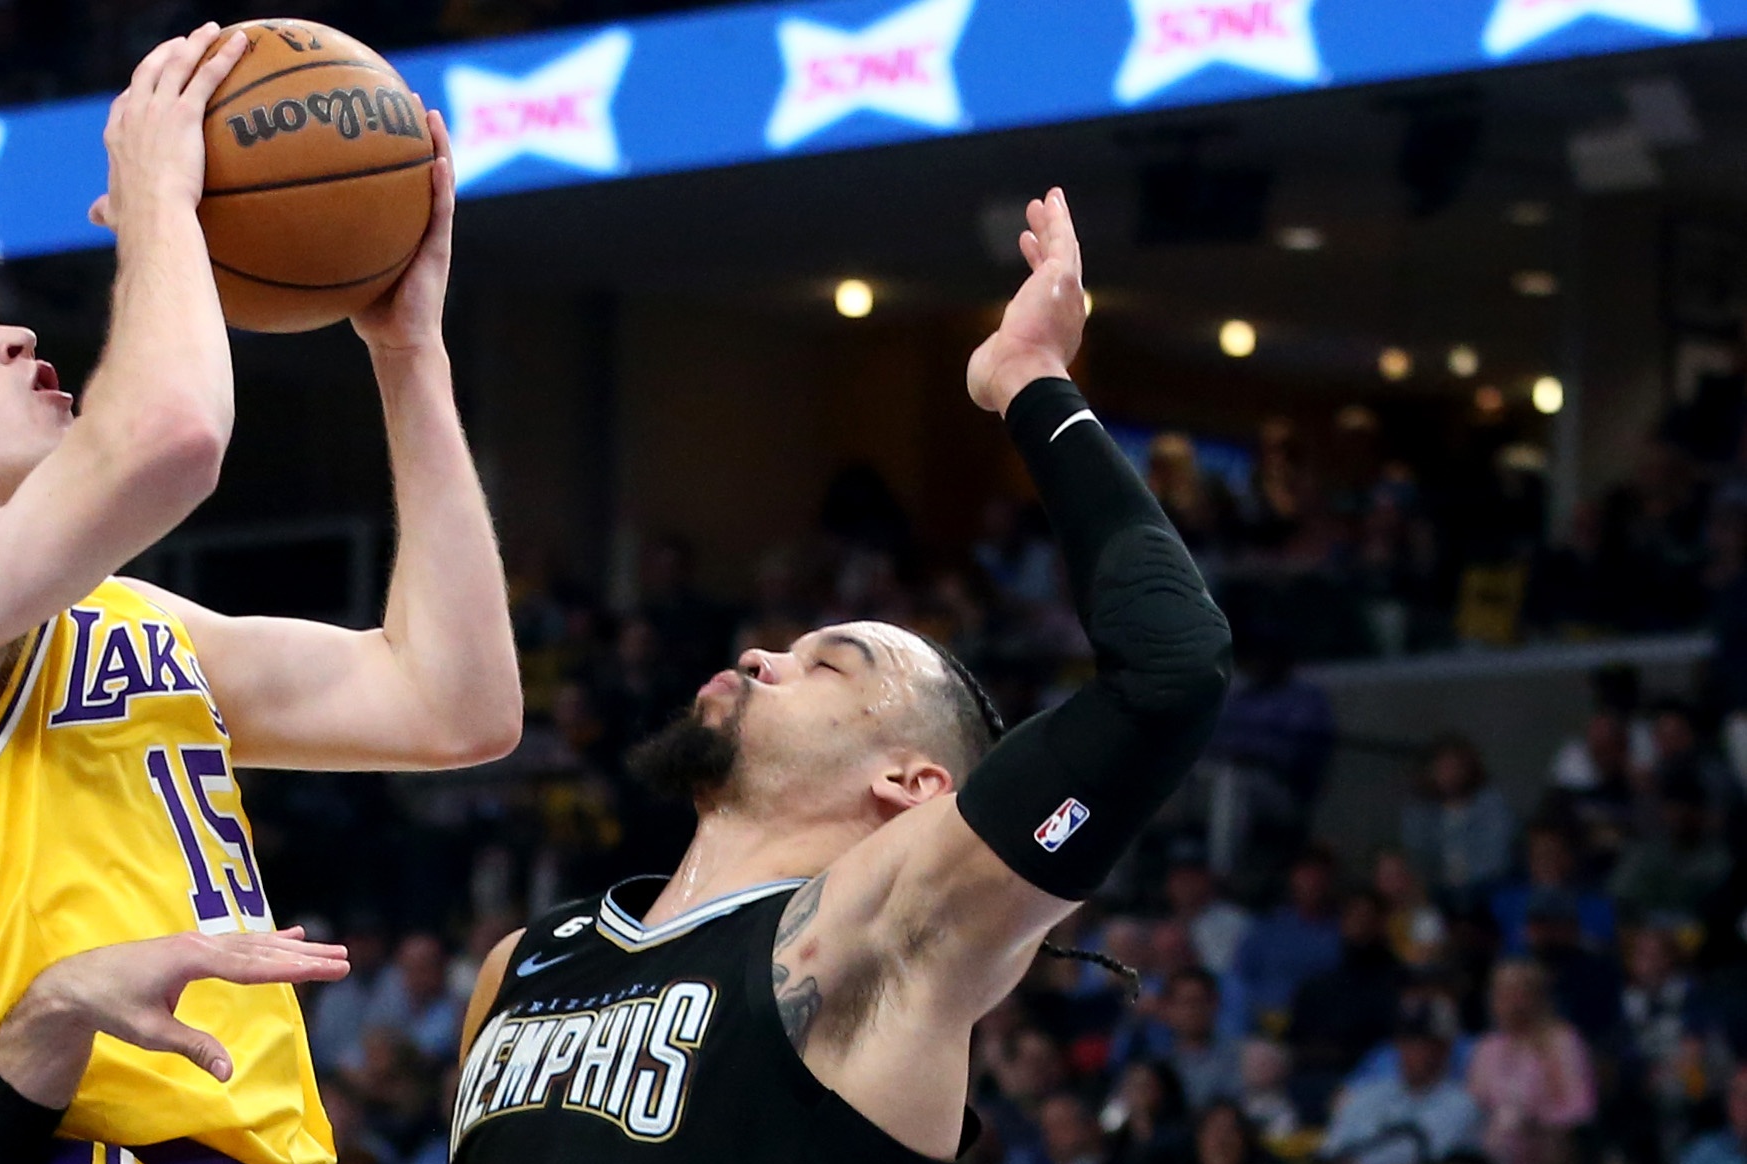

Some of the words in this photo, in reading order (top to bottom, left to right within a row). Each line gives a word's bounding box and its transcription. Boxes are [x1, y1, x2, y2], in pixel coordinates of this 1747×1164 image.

[226, 85, 425, 148] Wilson
[143, 743, 275, 936] 15
[552, 915, 594, 939] 6
[449, 979, 717, 1161] MEMPHIS
